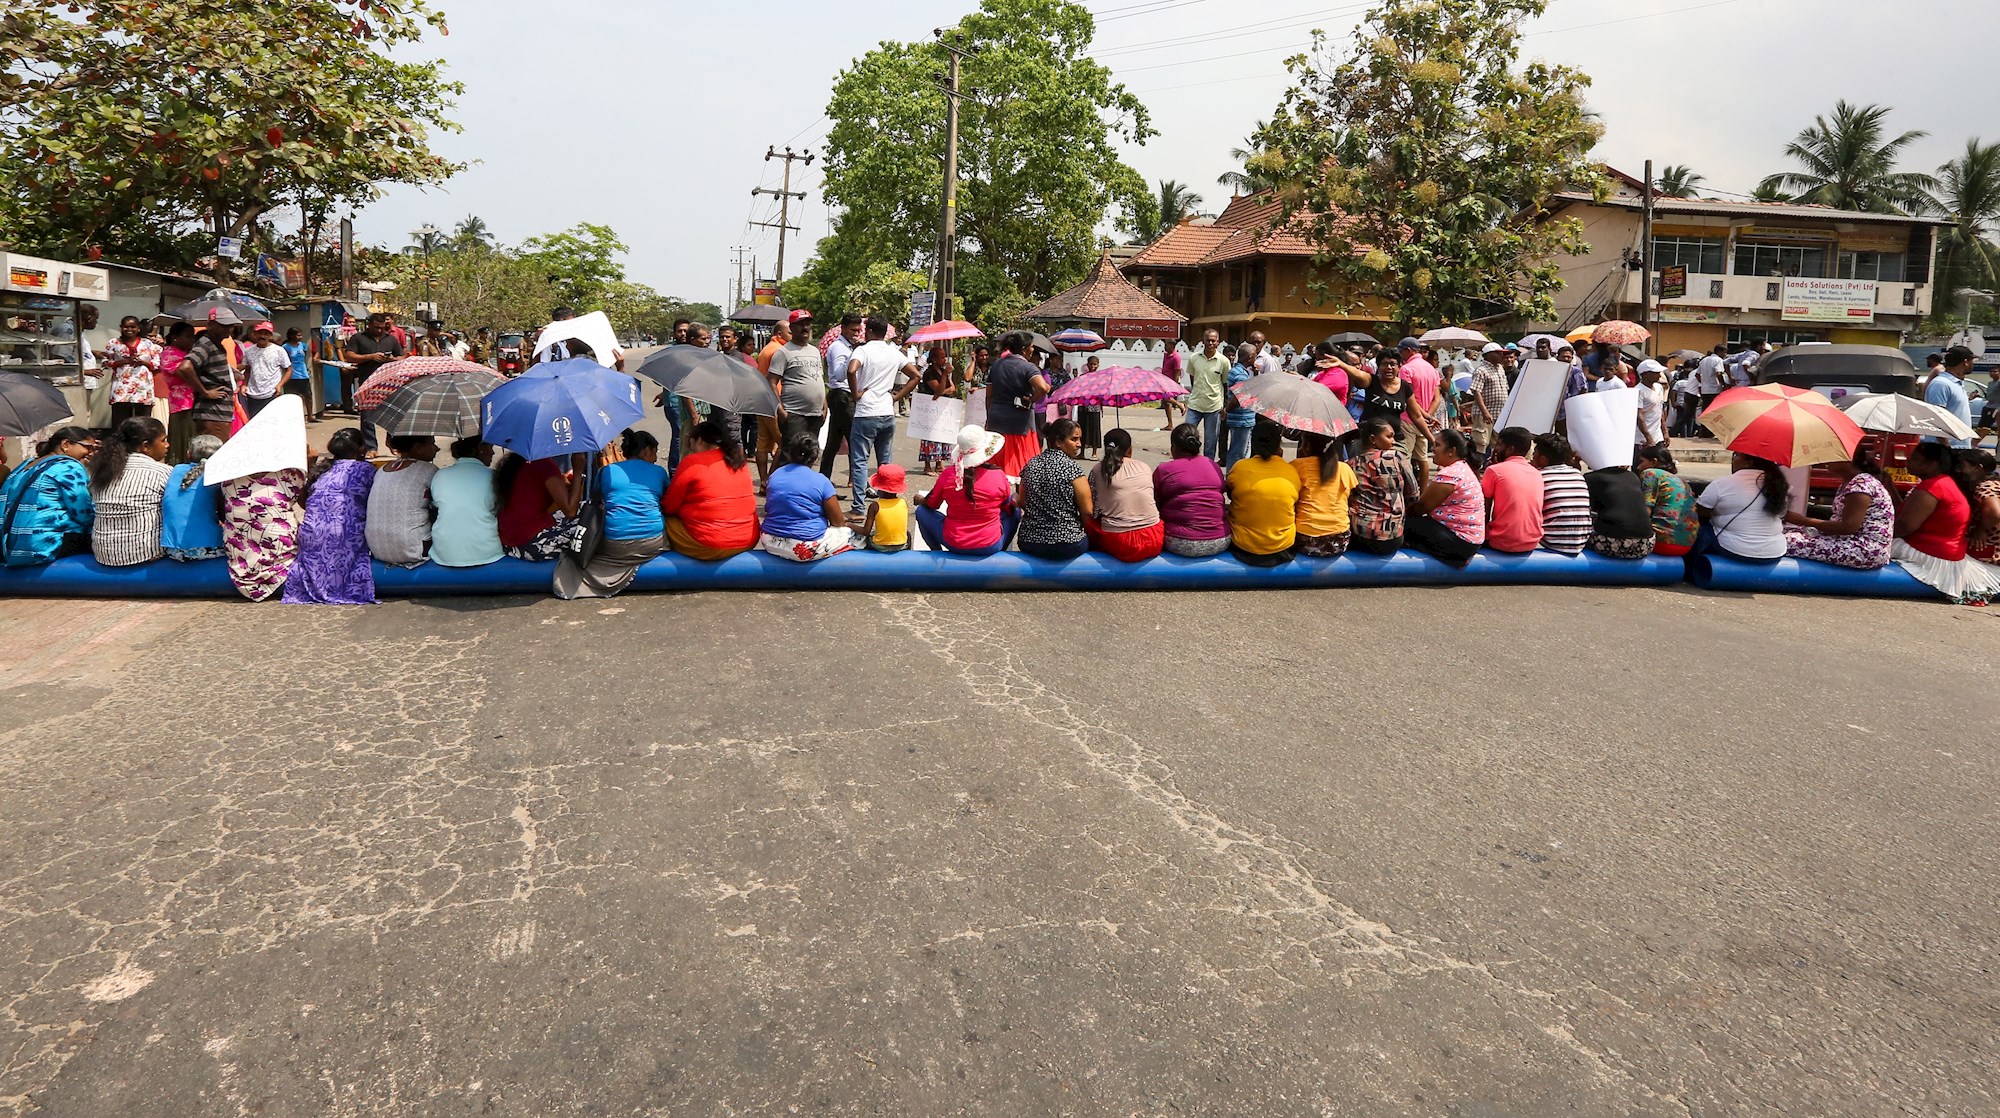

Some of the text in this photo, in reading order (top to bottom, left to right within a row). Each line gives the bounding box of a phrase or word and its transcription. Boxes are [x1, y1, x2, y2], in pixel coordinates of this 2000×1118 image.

[1810, 281, 1843, 289] Solutions
[1846, 282, 1861, 291] (Pvt)
[1371, 393, 1407, 410] ZAR
